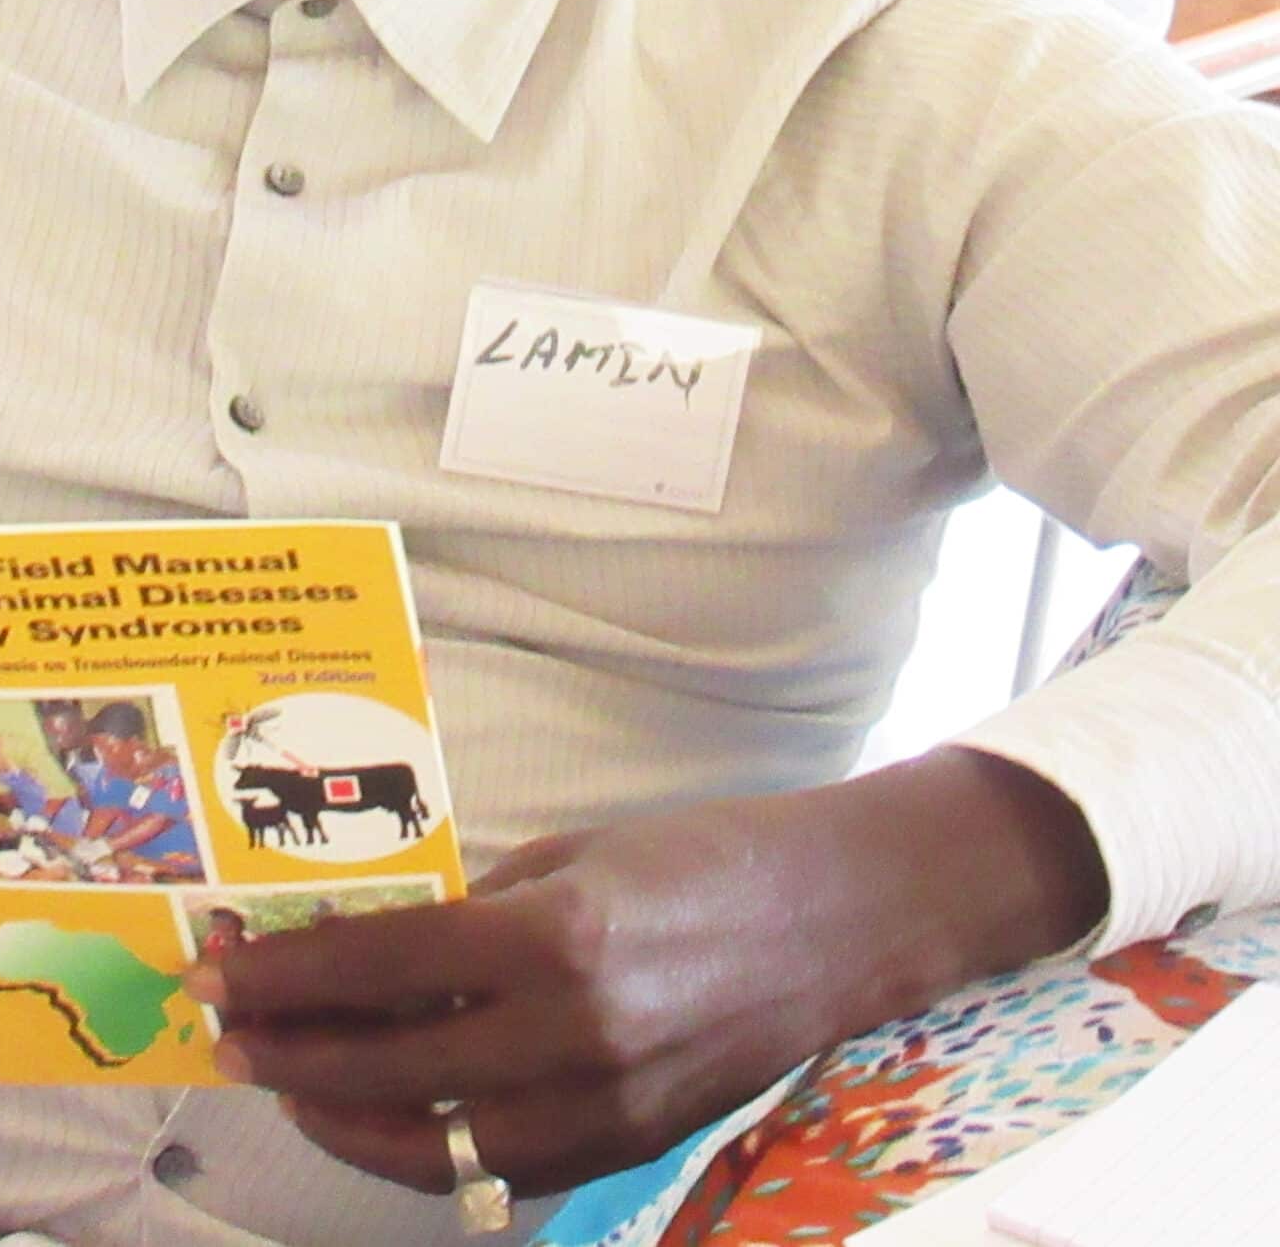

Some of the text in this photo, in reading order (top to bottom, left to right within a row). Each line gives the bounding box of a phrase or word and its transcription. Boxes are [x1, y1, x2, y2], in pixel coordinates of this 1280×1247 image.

[474, 318, 703, 411] LAMIN
[112, 549, 299, 576] Manual
[138, 582, 359, 607] Diseases
[27, 616, 304, 646] Syndromes
[73, 651, 210, 672] Transboundary
[215, 649, 281, 664] Animal
[286, 647, 373, 662] Diseases
[260, 669, 376, 685] 2nd Edition
